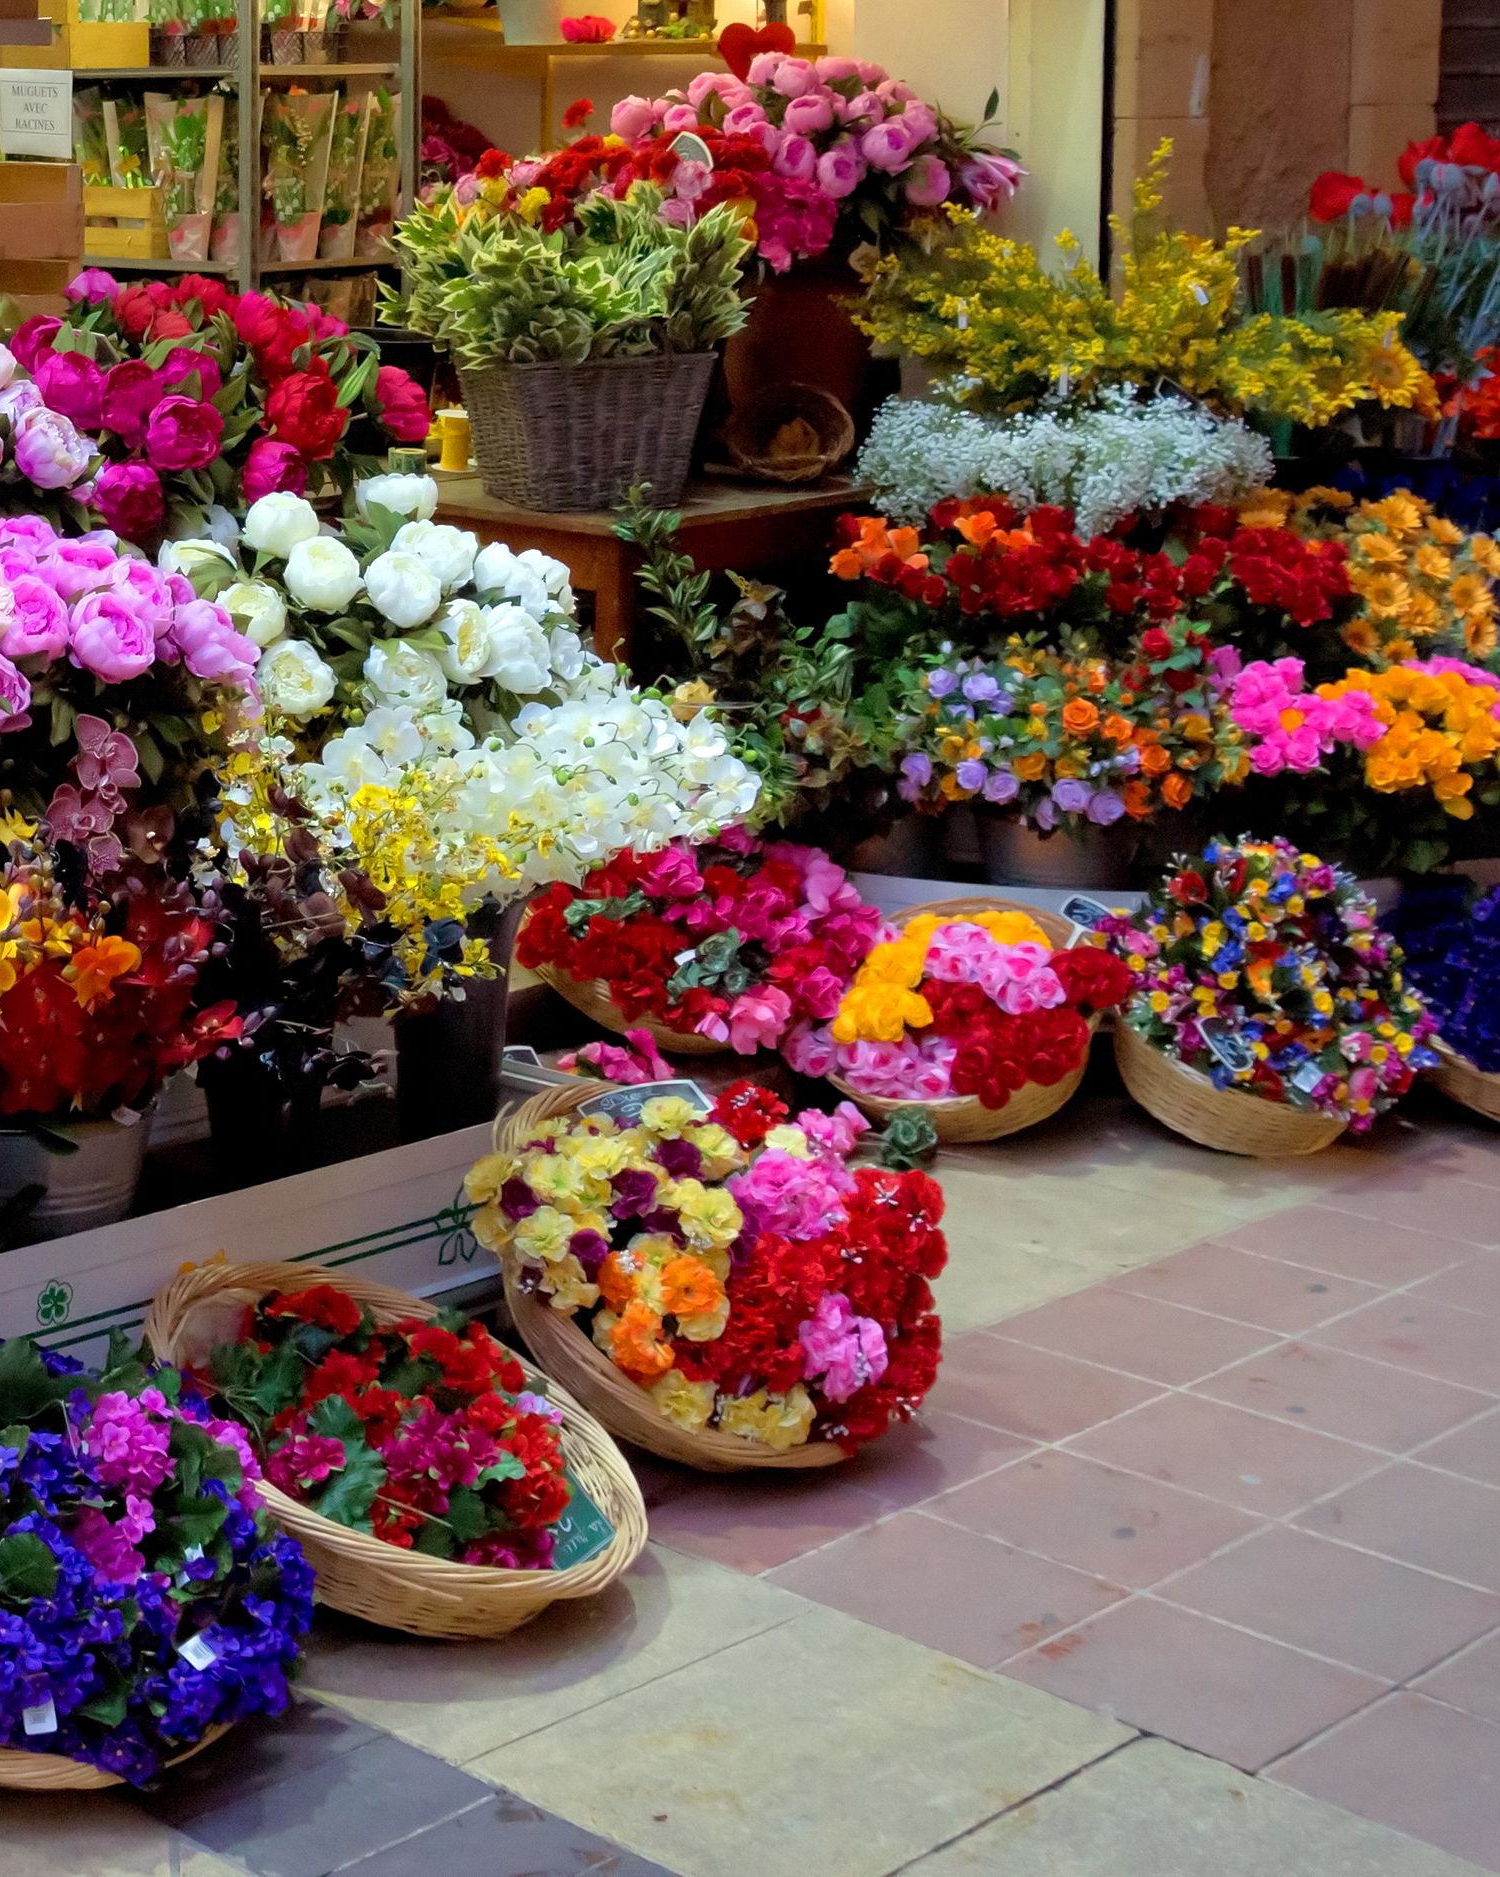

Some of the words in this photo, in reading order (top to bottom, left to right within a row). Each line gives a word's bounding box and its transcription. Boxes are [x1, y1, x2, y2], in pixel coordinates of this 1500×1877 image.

[12, 85, 58, 98] MUGUETS
[23, 102, 48, 114] AVEC
[15, 117, 55, 131] RACINES
